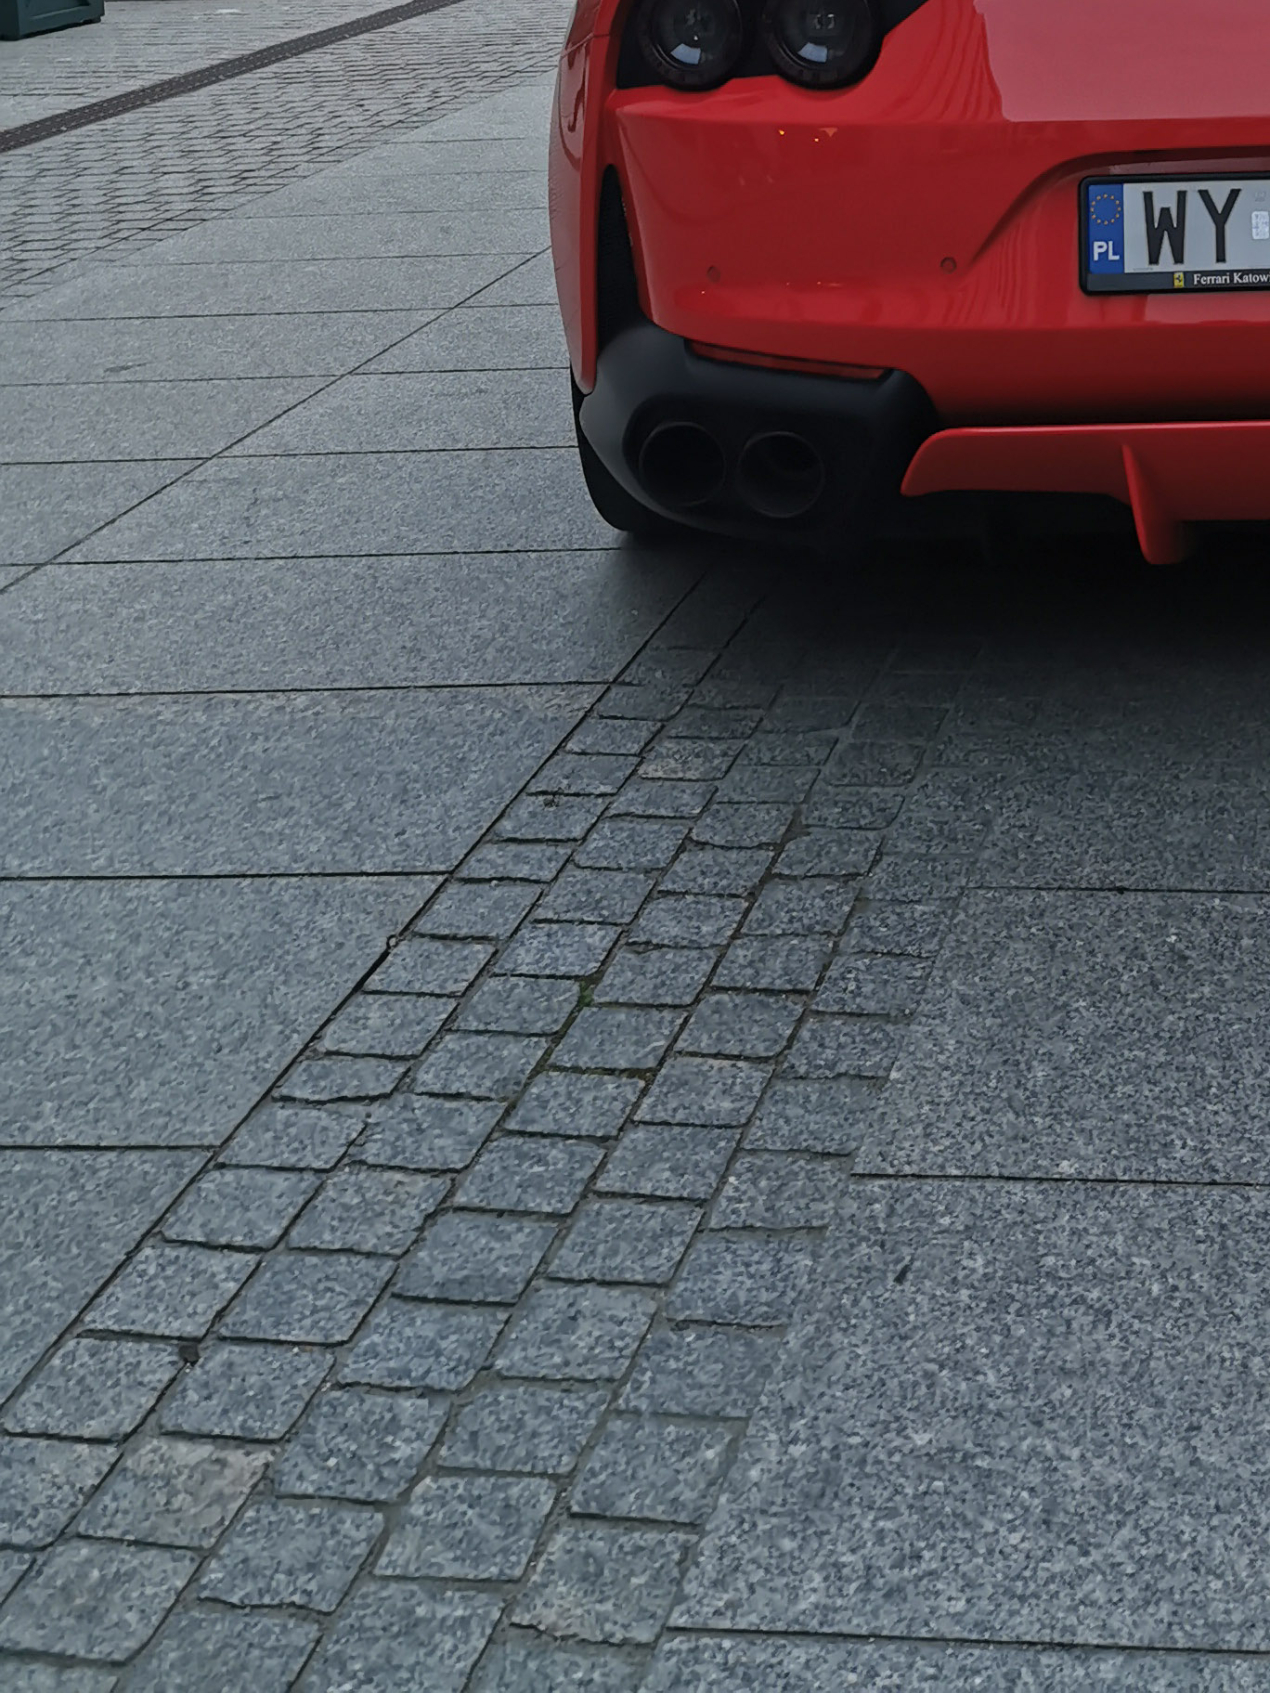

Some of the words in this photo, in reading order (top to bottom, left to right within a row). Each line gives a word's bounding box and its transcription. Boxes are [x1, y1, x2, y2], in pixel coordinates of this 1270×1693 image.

[1142, 188, 1243, 266] WY
[1092, 241, 1121, 262] PL
[1193, 273, 1230, 286] Ferrari
